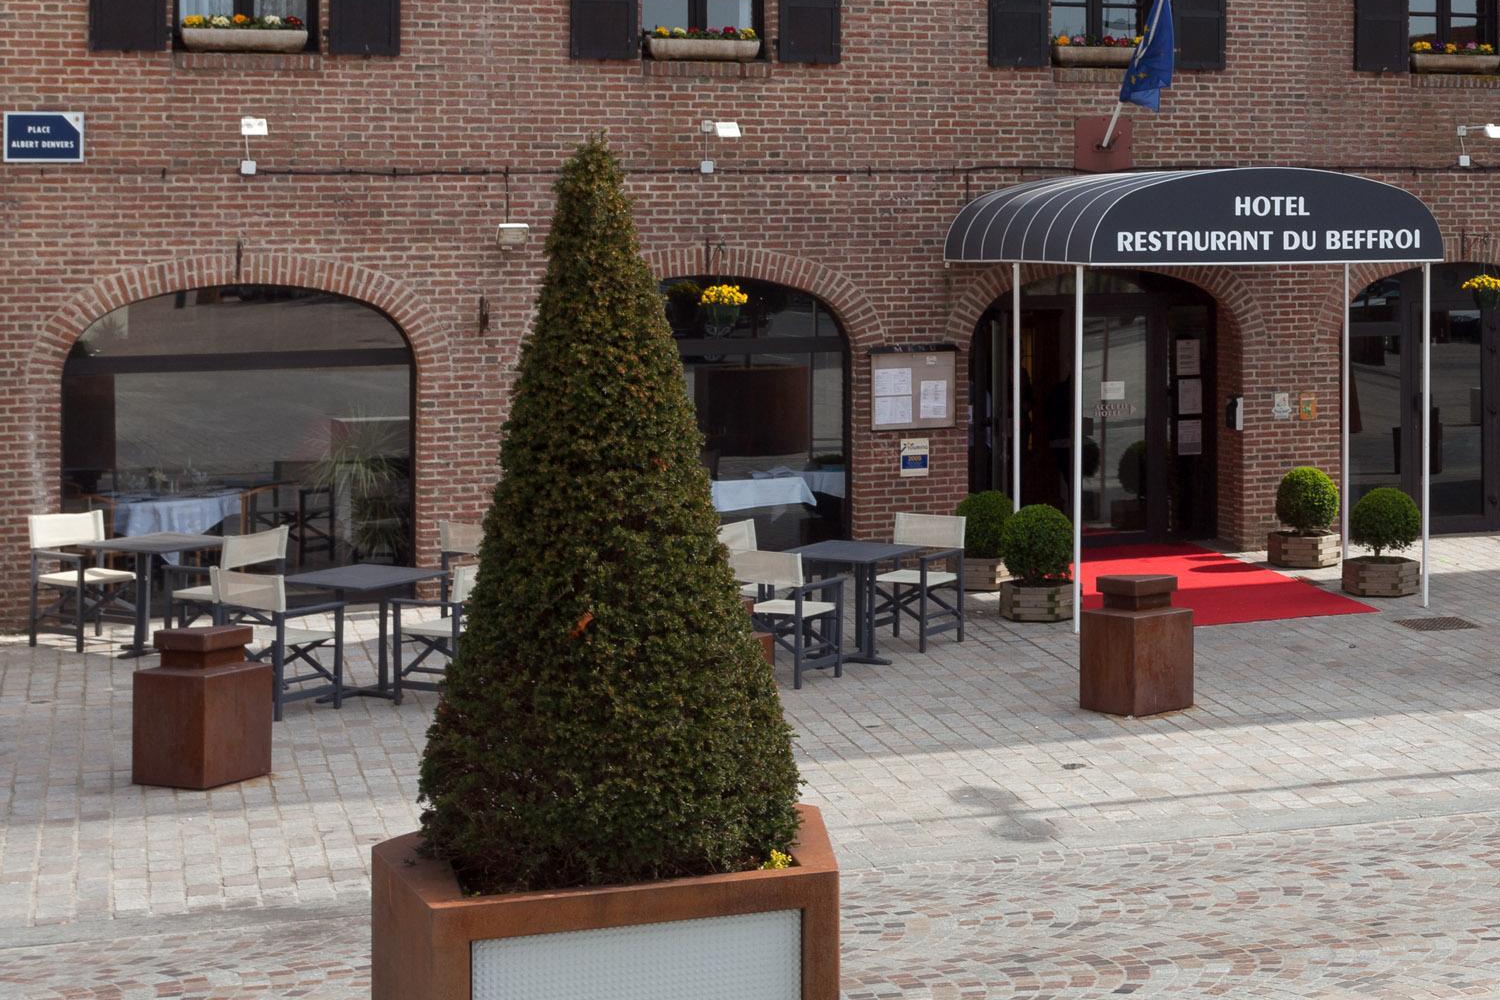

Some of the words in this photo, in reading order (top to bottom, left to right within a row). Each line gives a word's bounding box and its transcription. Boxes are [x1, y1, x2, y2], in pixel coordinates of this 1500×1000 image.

[11, 140, 39, 148] ALBERT
[41, 140, 74, 148] DENVERS
[1235, 196, 1310, 217] HOTEL
[1117, 230, 1274, 252] RESTAURANT
[1283, 230, 1317, 251] DU
[1326, 228, 1421, 250] BEFFROI
